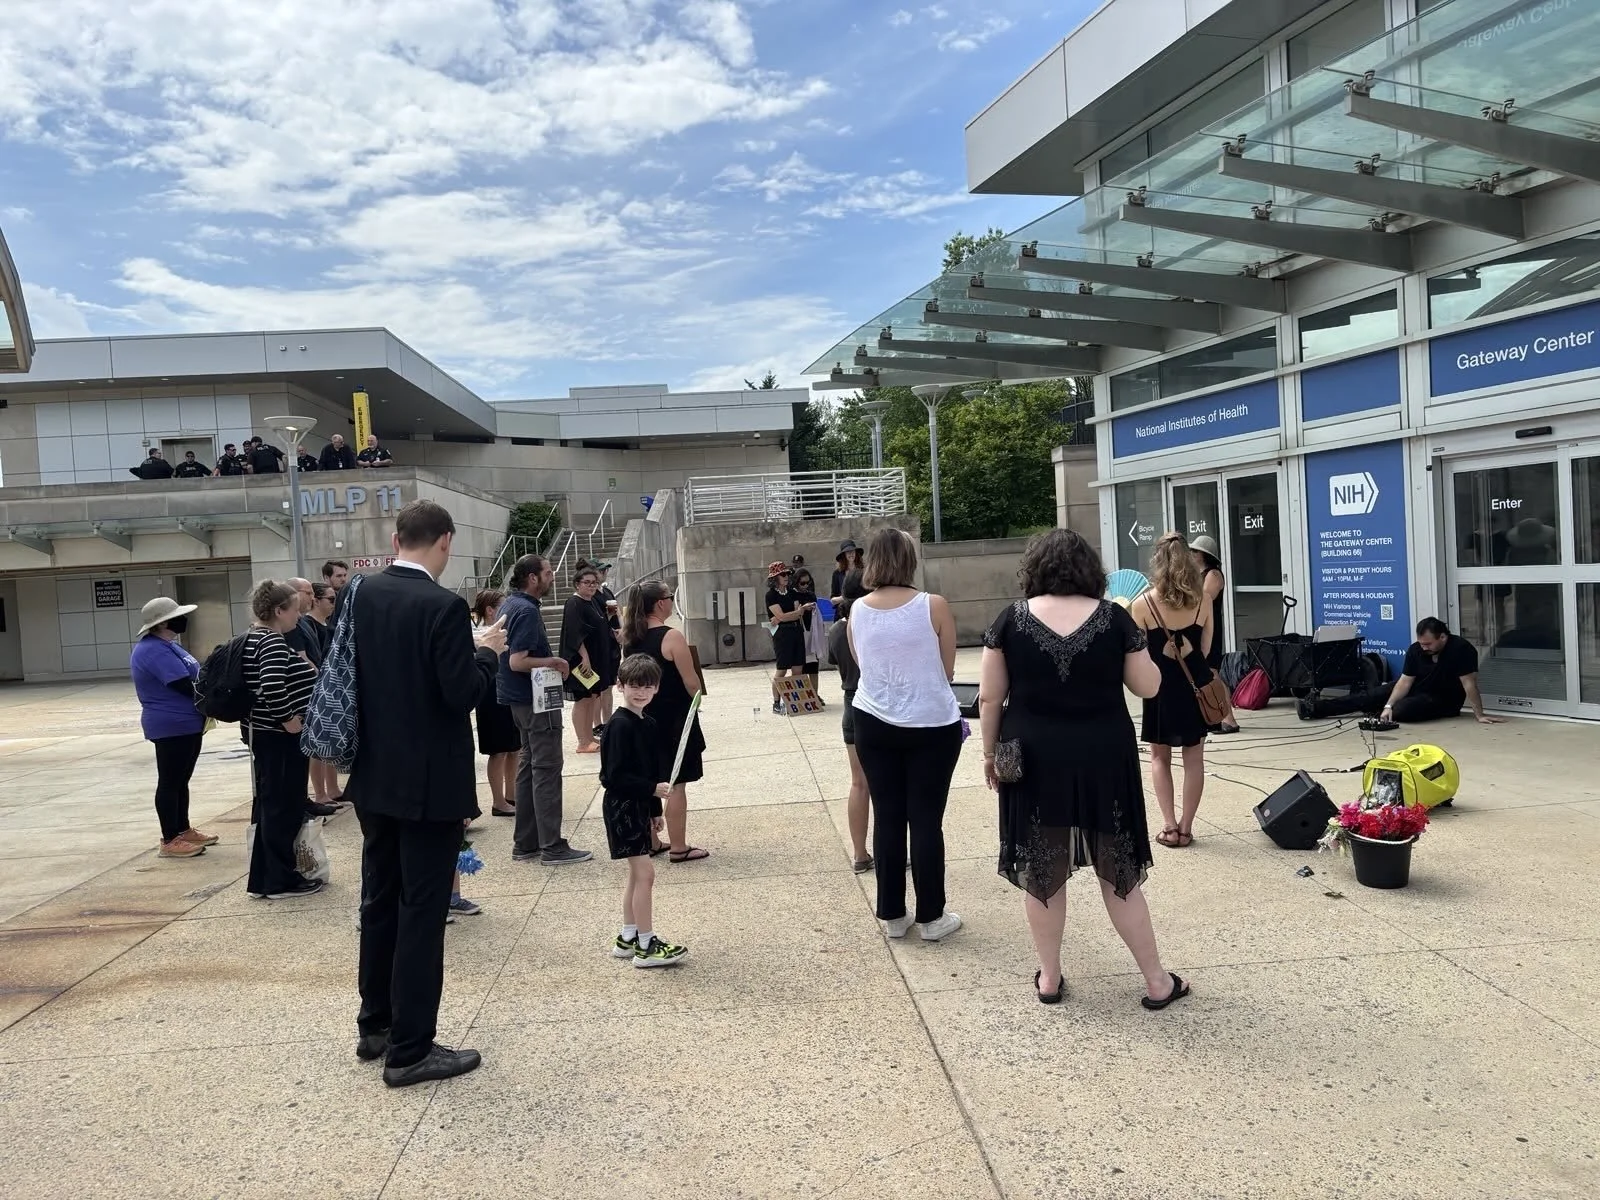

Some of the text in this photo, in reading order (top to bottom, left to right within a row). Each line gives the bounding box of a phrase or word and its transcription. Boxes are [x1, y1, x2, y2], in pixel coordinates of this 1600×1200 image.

[1456, 330, 1595, 370] Gateway Center
[357, 406, 365, 447] EMERGENCY
[1135, 403, 1248, 439] National Institutes of Health
[1334, 483, 1365, 505] NIH
[300, 485, 401, 516] MLP 11
[1491, 498, 1522, 510] Enter
[1189, 520, 1207, 534] Exit
[1244, 514, 1264, 529] Exit
[1320, 529, 1362, 539] WELCOME TO
[1333, 539, 1364, 548] GATEWAY
[1365, 537, 1393, 546] CENTER
[1321, 549, 1351, 558] (BUILDING
[353, 559, 371, 568] FDC
[1350, 619, 1367, 627] Facility
[1380, 647, 1397, 655] Phone
[790, 701, 819, 713] BACK
